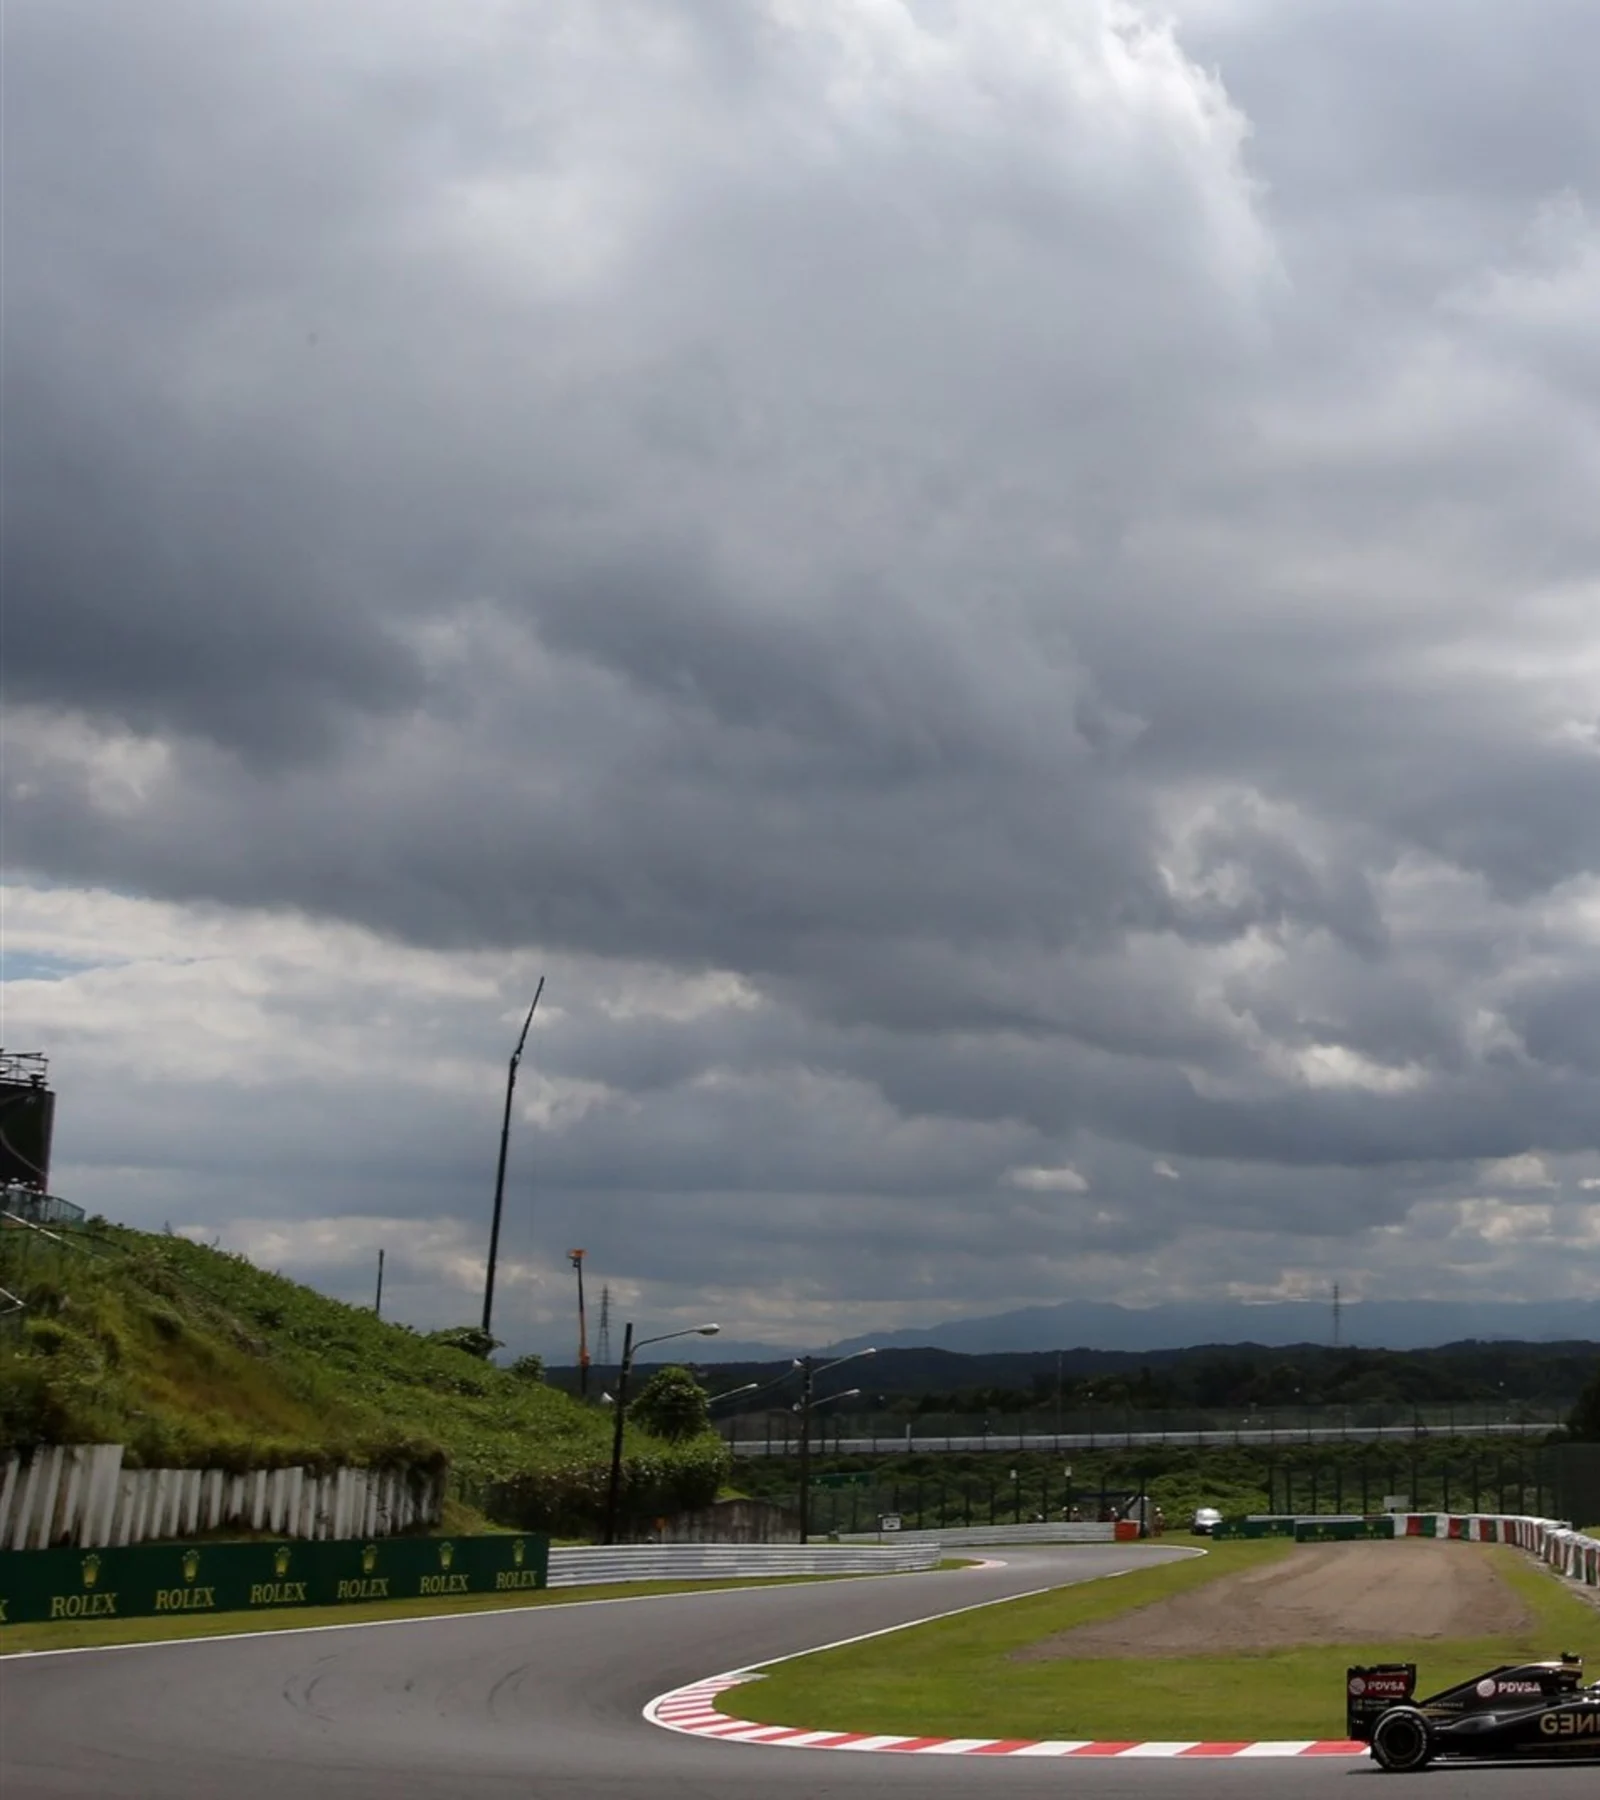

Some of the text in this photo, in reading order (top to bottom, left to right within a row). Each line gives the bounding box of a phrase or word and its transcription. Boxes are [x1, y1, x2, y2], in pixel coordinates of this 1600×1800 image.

[337, 1578, 389, 1599] ROLEX
[420, 1574, 470, 1594] ROLEX
[496, 1571, 538, 1589] ROLEX
[154, 1587, 215, 1610] ROLEX
[250, 1582, 308, 1603] ROLEX
[51, 1592, 118, 1618] ROLEX
[1367, 1681, 1405, 1691] PDVSA
[1498, 1681, 1542, 1693] PDVSA
